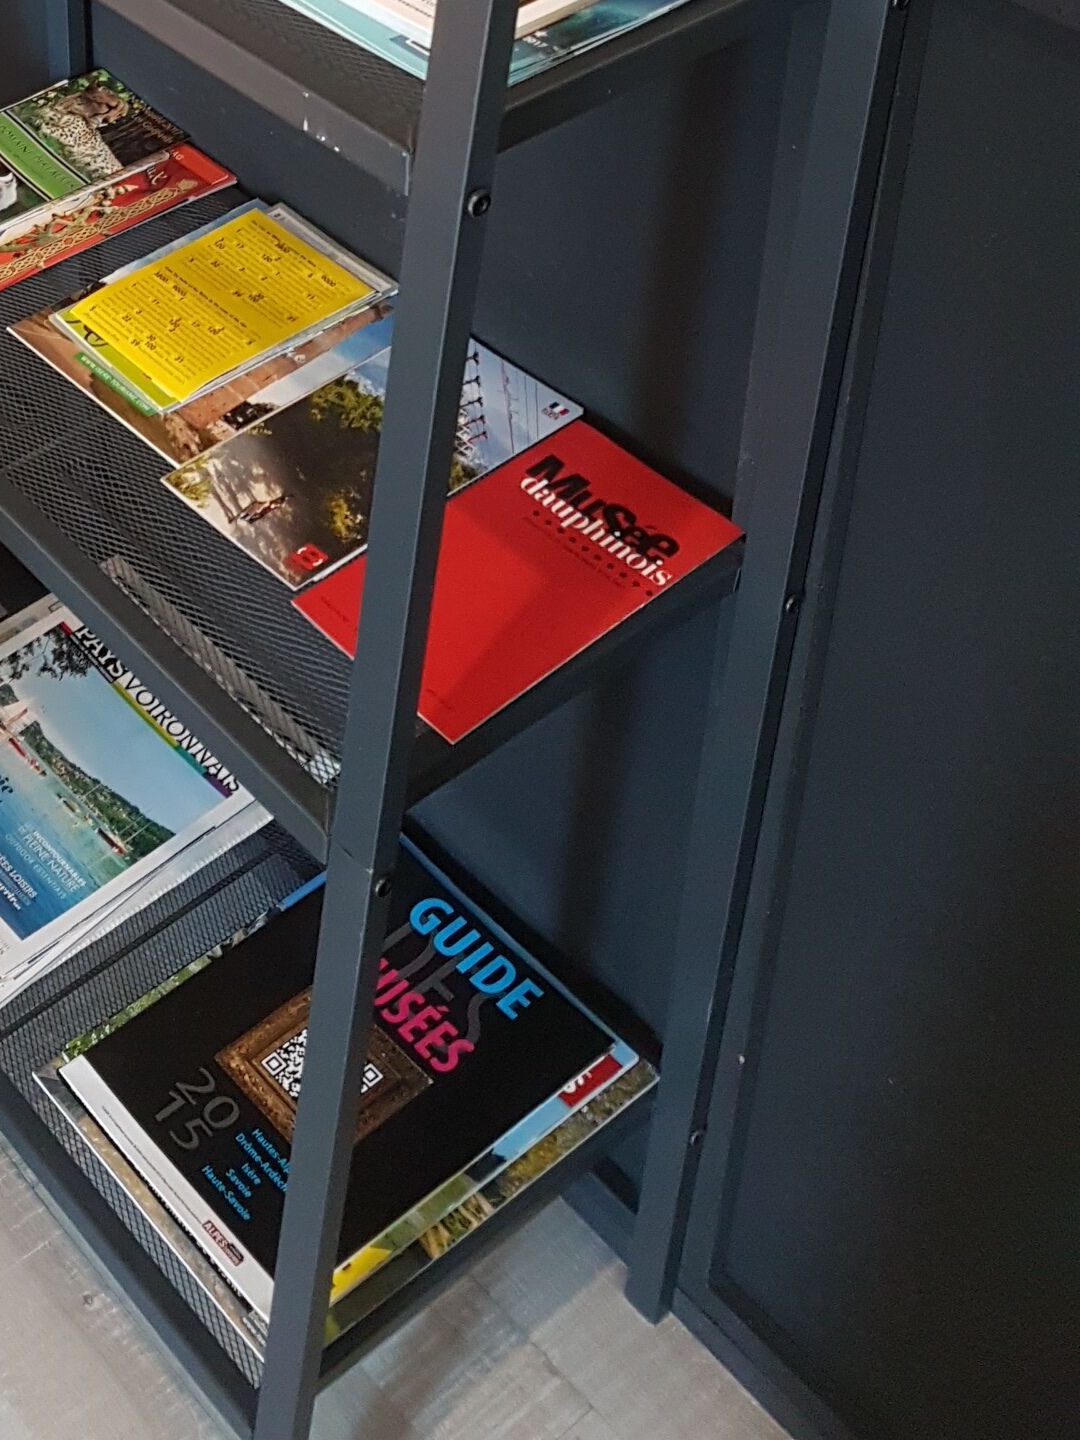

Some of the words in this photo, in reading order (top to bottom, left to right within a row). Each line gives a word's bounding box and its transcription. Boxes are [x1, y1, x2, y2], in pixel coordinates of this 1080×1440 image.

[520, 476, 673, 586] dauphinois
[76, 626, 123, 678] PAYS
[123, 671, 240, 794] VOIRONNAIS
[8, 868, 38, 899] LOISIRS
[23, 834, 48, 862] PLEINE
[47, 859, 81, 892] NATURE
[409, 897, 545, 1021] GUIDE
[374, 957, 476, 1073] USÉES
[155, 1089, 214, 1150] 15
[175, 1067, 240, 1128] 20
[235, 1132, 289, 1194] Drôme-Ardèch
[241, 1162, 262, 1187] Isère
[250, 1127, 292, 1175] Hautes-Alp
[201, 1164, 252, 1222] Haute-Savoie
[225, 1167, 252, 1199] Savoie
[202, 1220, 229, 1252] ALPES
